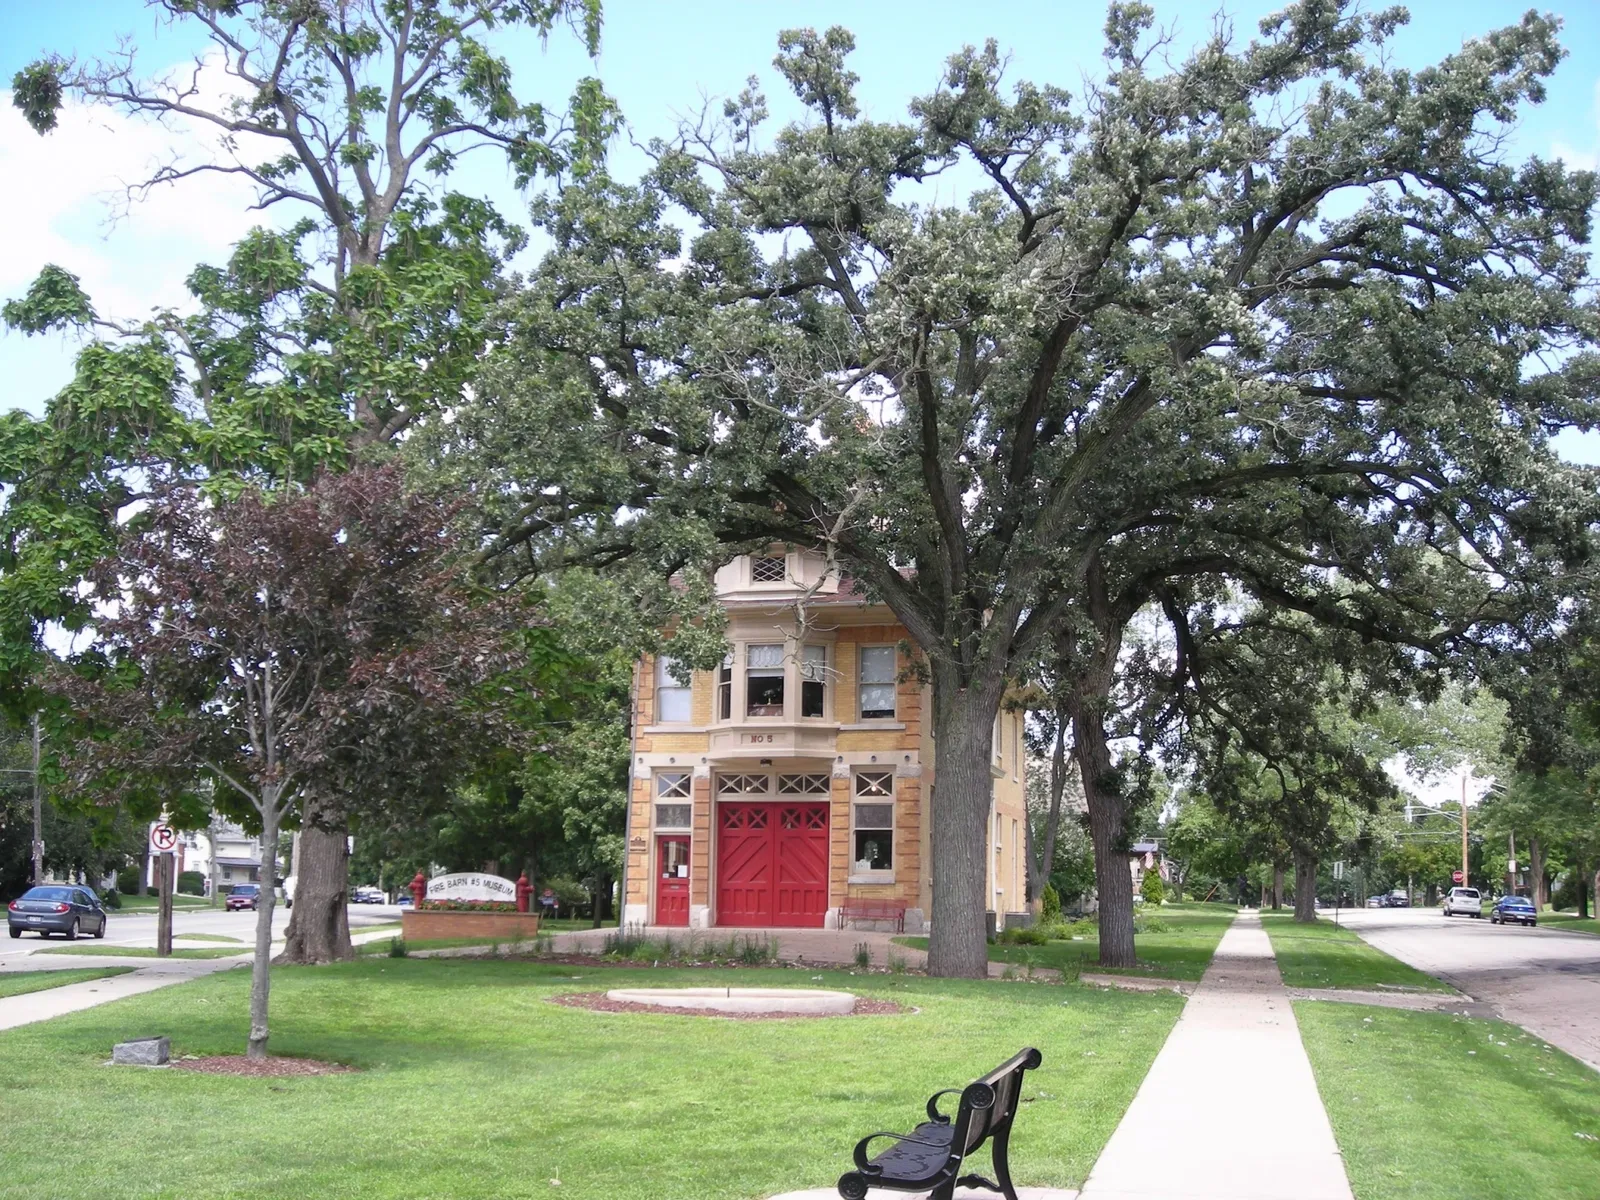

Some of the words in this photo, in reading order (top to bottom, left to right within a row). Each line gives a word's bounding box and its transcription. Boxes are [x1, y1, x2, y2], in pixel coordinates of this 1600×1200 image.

[751, 735, 764, 743] NO
[767, 735, 773, 743] 5
[429, 882, 445, 894] FIRE
[447, 877, 468, 889] BARN
[470, 878, 481, 887] #5
[483, 879, 514, 896] MUSEUM
